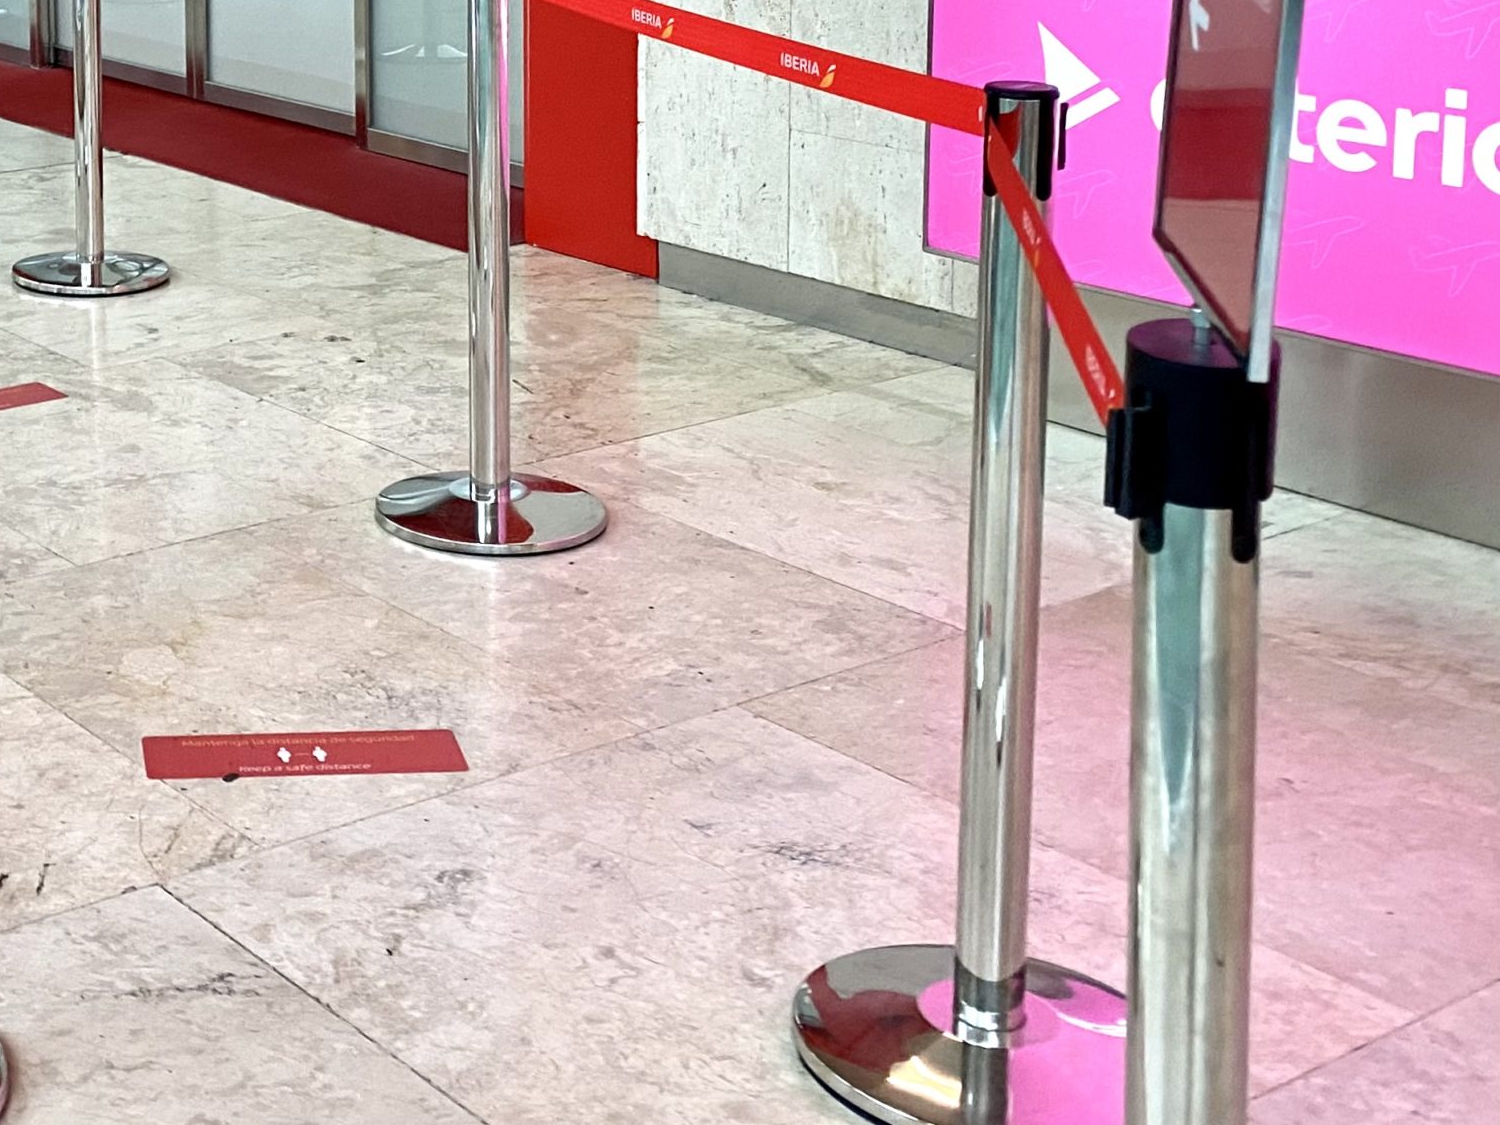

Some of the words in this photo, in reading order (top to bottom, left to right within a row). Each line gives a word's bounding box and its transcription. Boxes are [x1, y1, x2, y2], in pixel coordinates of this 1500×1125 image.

[631, 8, 662, 29] IBERIA
[780, 51, 820, 77] IBERIA
[331, 736, 346, 744] de
[239, 765, 272, 774] Keep
[286, 763, 312, 772] safe
[315, 762, 372, 772] distance
